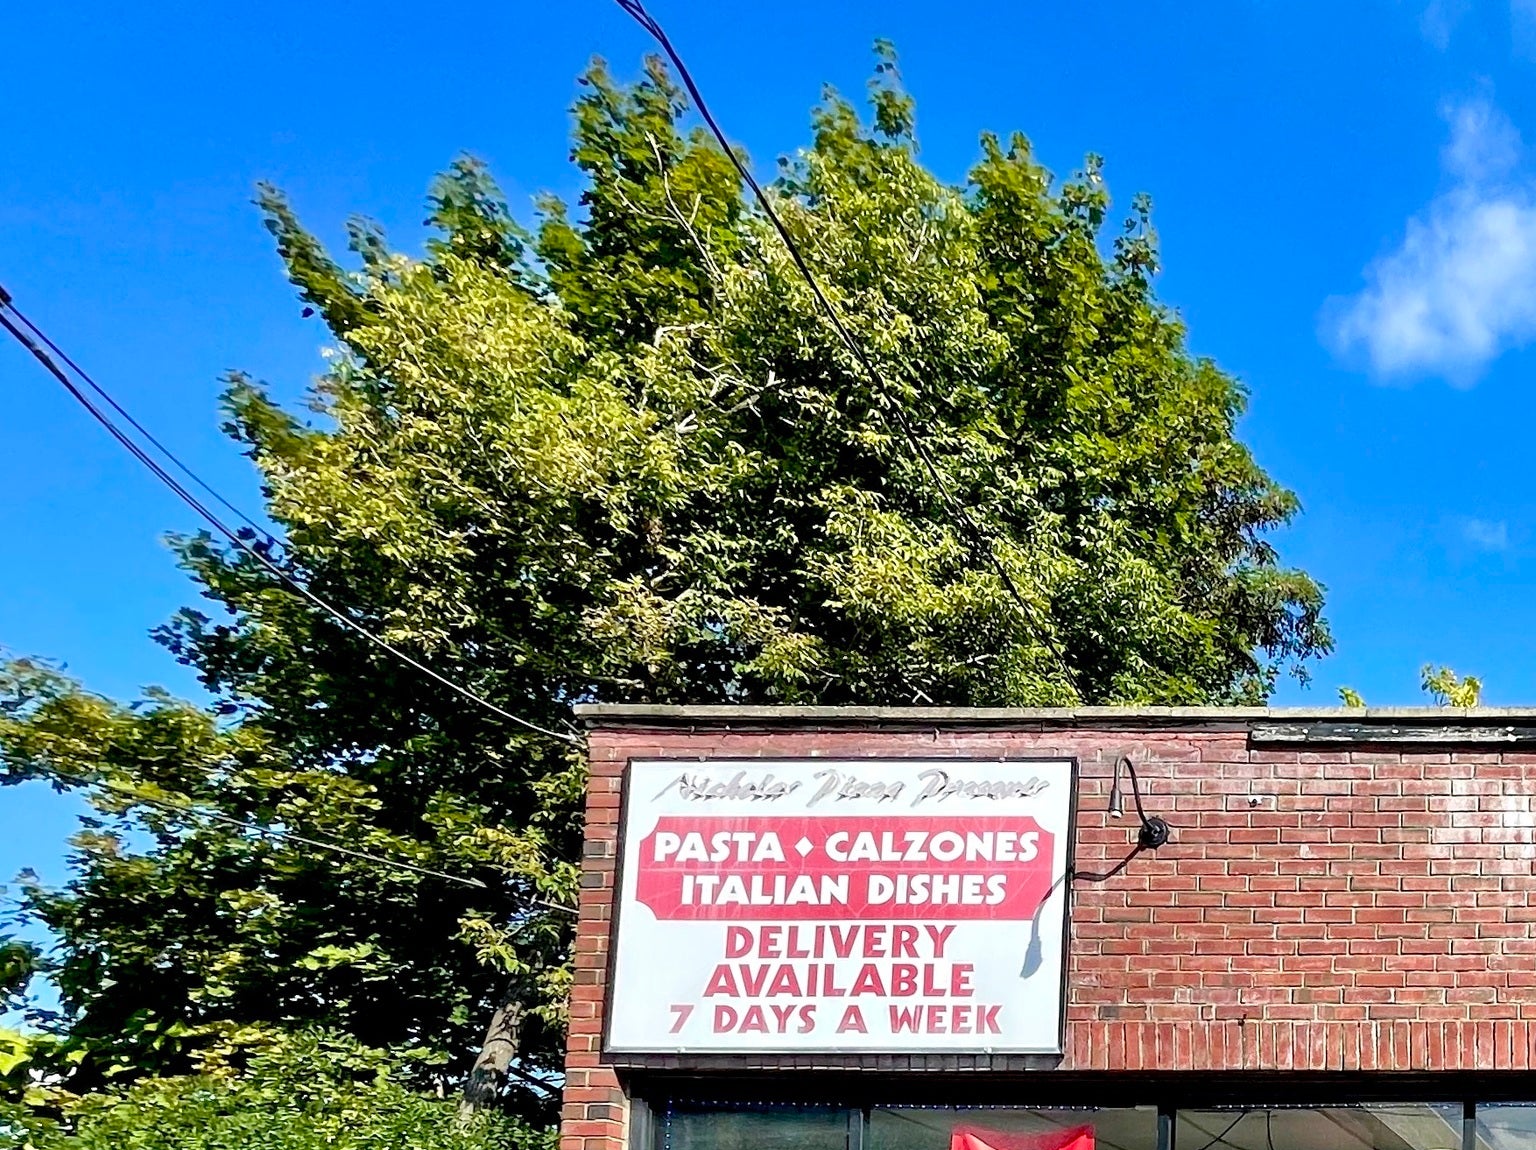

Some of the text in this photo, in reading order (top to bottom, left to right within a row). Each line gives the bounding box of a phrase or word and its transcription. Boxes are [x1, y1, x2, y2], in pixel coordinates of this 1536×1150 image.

[653, 830, 1040, 863] PASTA CALZONES
[680, 873, 1007, 905] ITALIAN DISHES
[724, 924, 956, 959] DELIVERY
[702, 963, 976, 998] AVAILABLE
[668, 1004, 1004, 1034] 7 DAYS A WEEK
